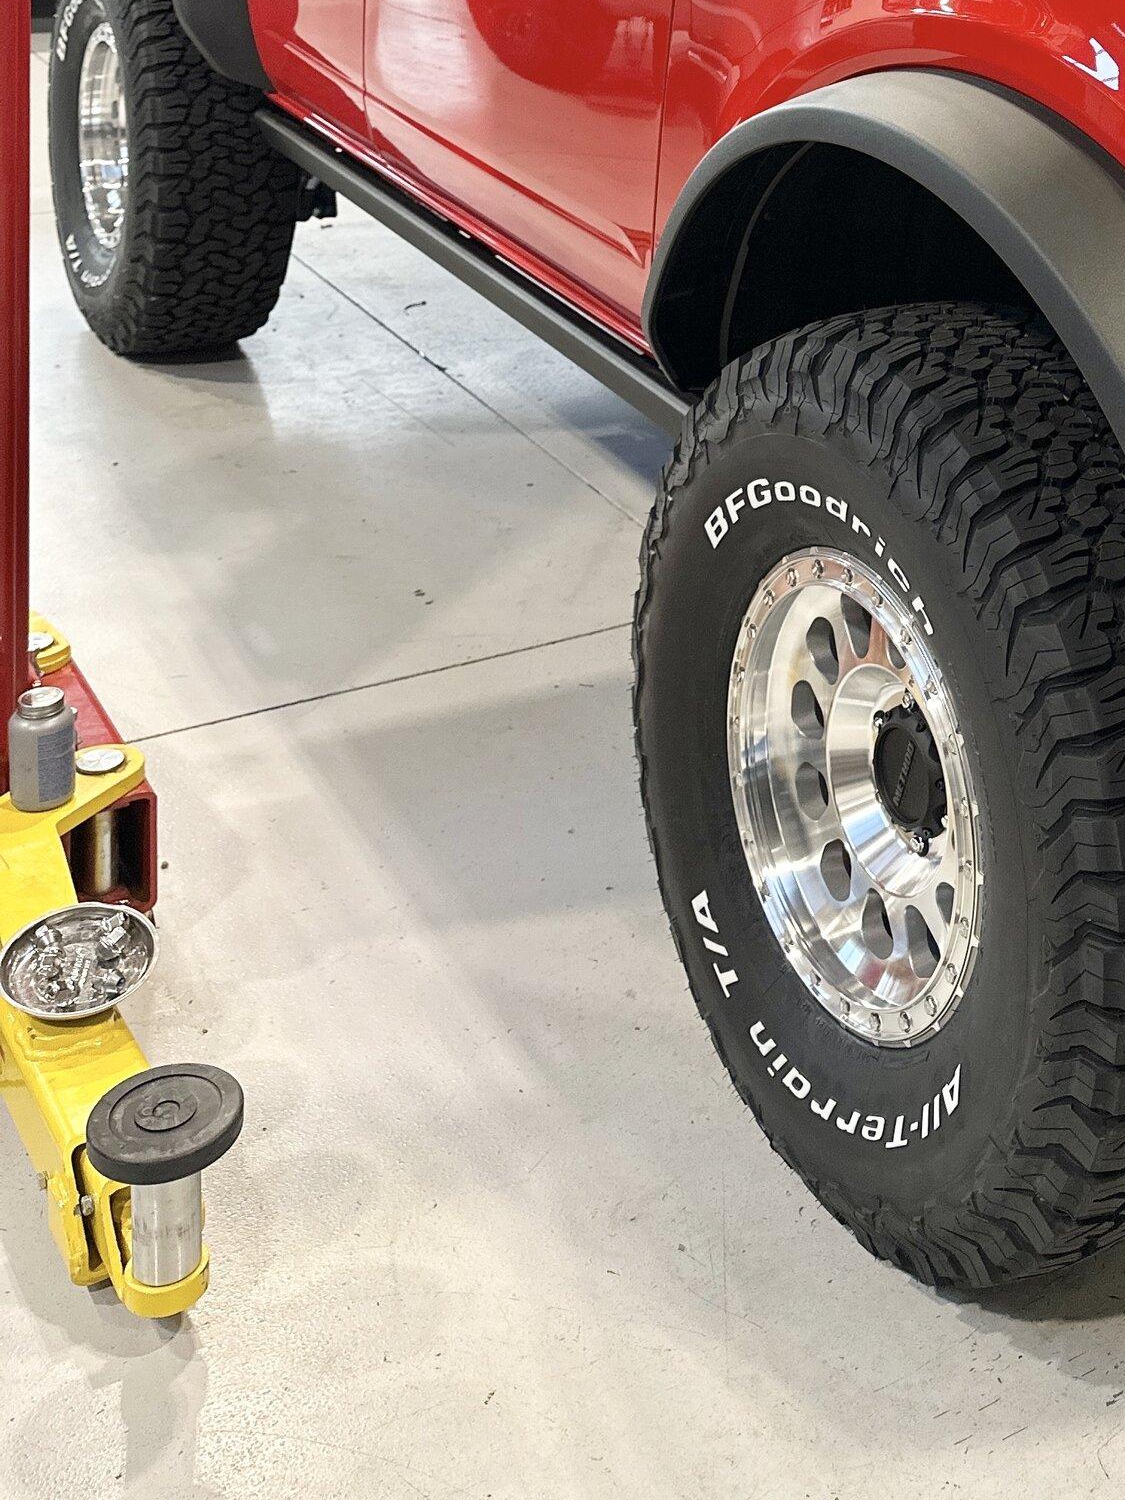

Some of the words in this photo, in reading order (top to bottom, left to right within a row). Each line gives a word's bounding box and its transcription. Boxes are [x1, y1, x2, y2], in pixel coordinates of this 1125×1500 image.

[703, 478, 934, 635] BFGoodrich
[691, 889, 739, 998] T/A
[749, 1020, 962, 1149] All-Terrain
